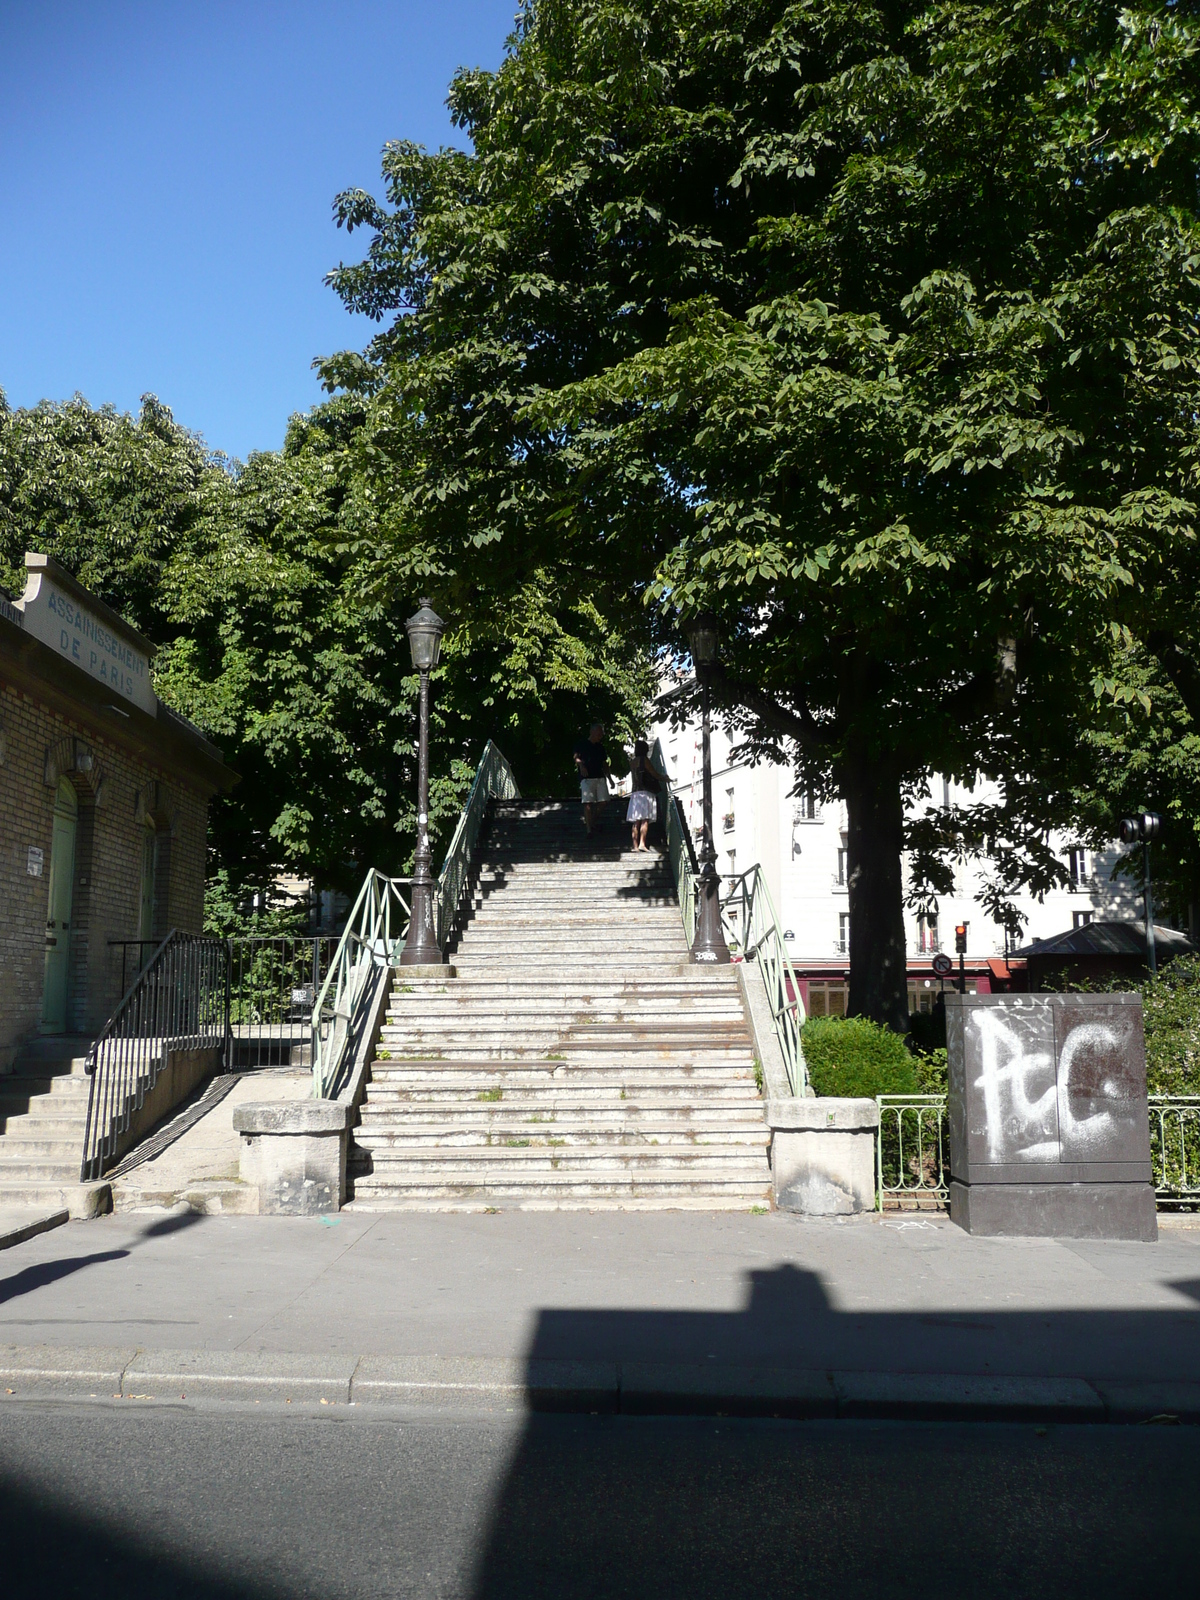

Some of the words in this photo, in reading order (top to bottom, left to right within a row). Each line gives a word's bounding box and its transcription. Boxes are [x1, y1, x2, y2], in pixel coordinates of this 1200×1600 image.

[48, 592, 145, 677] ASSAINISSEMENT
[60, 629, 81, 660] DE
[90, 651, 133, 695] PARIS
